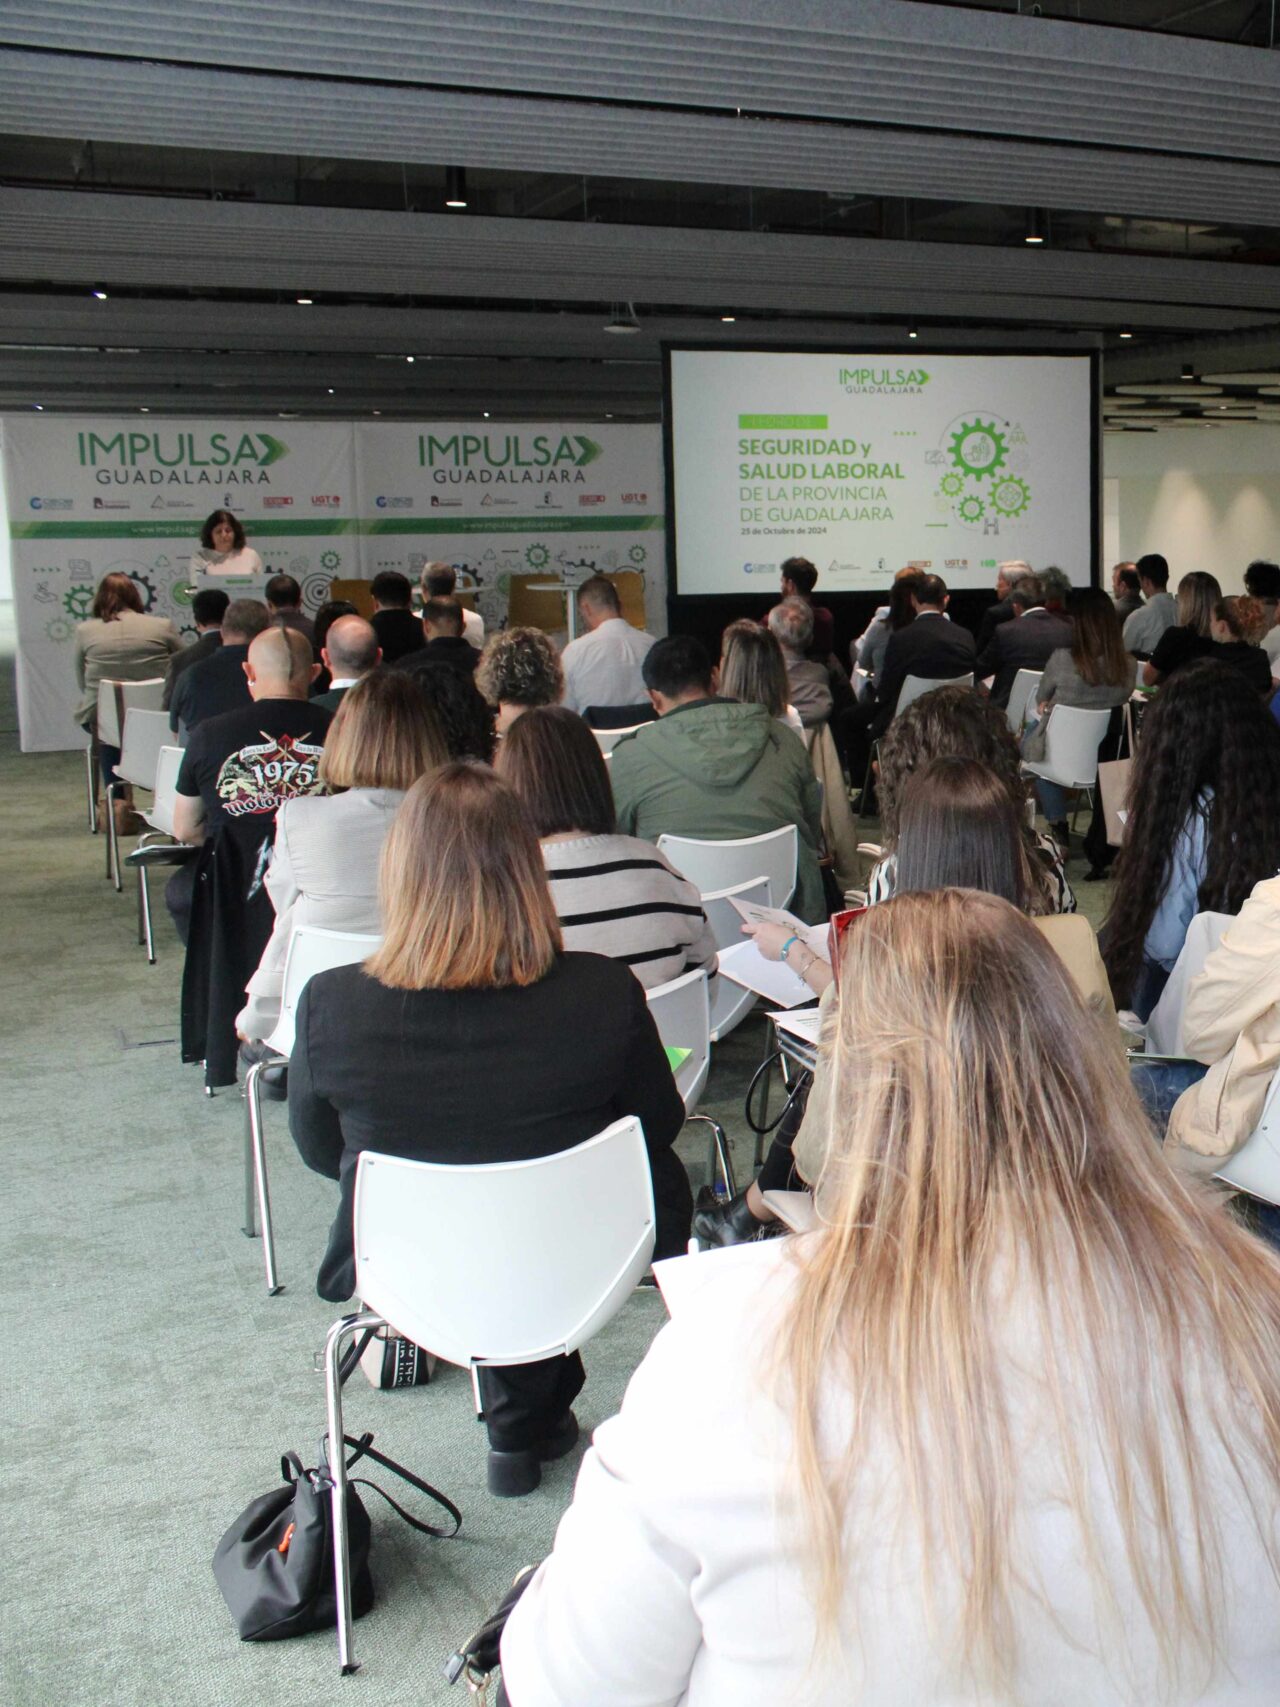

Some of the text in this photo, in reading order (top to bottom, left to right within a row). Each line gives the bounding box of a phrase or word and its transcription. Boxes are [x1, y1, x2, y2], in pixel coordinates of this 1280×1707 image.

[839, 368, 917, 386] IMPULSA
[845, 386, 923, 394] GUADALAJARA
[78, 432, 258, 467] IMPULSA
[418, 435, 577, 467] IMPULSA
[738, 438, 871, 458] SEGURIDAD y
[96, 469, 271, 484] GUADALAJARA
[434, 469, 585, 484] GUADALAJARA
[738, 463, 905, 480] SALUD LABORAL
[739, 486, 887, 501] DE LA PROVINCIA
[740, 507, 894, 522] DE GUADALAJARA
[752, 527, 761, 535] de
[763, 527, 794, 535] Octubre
[796, 527, 806, 535] de
[807, 527, 827, 535] 2024
[251, 761, 315, 786] 1975
